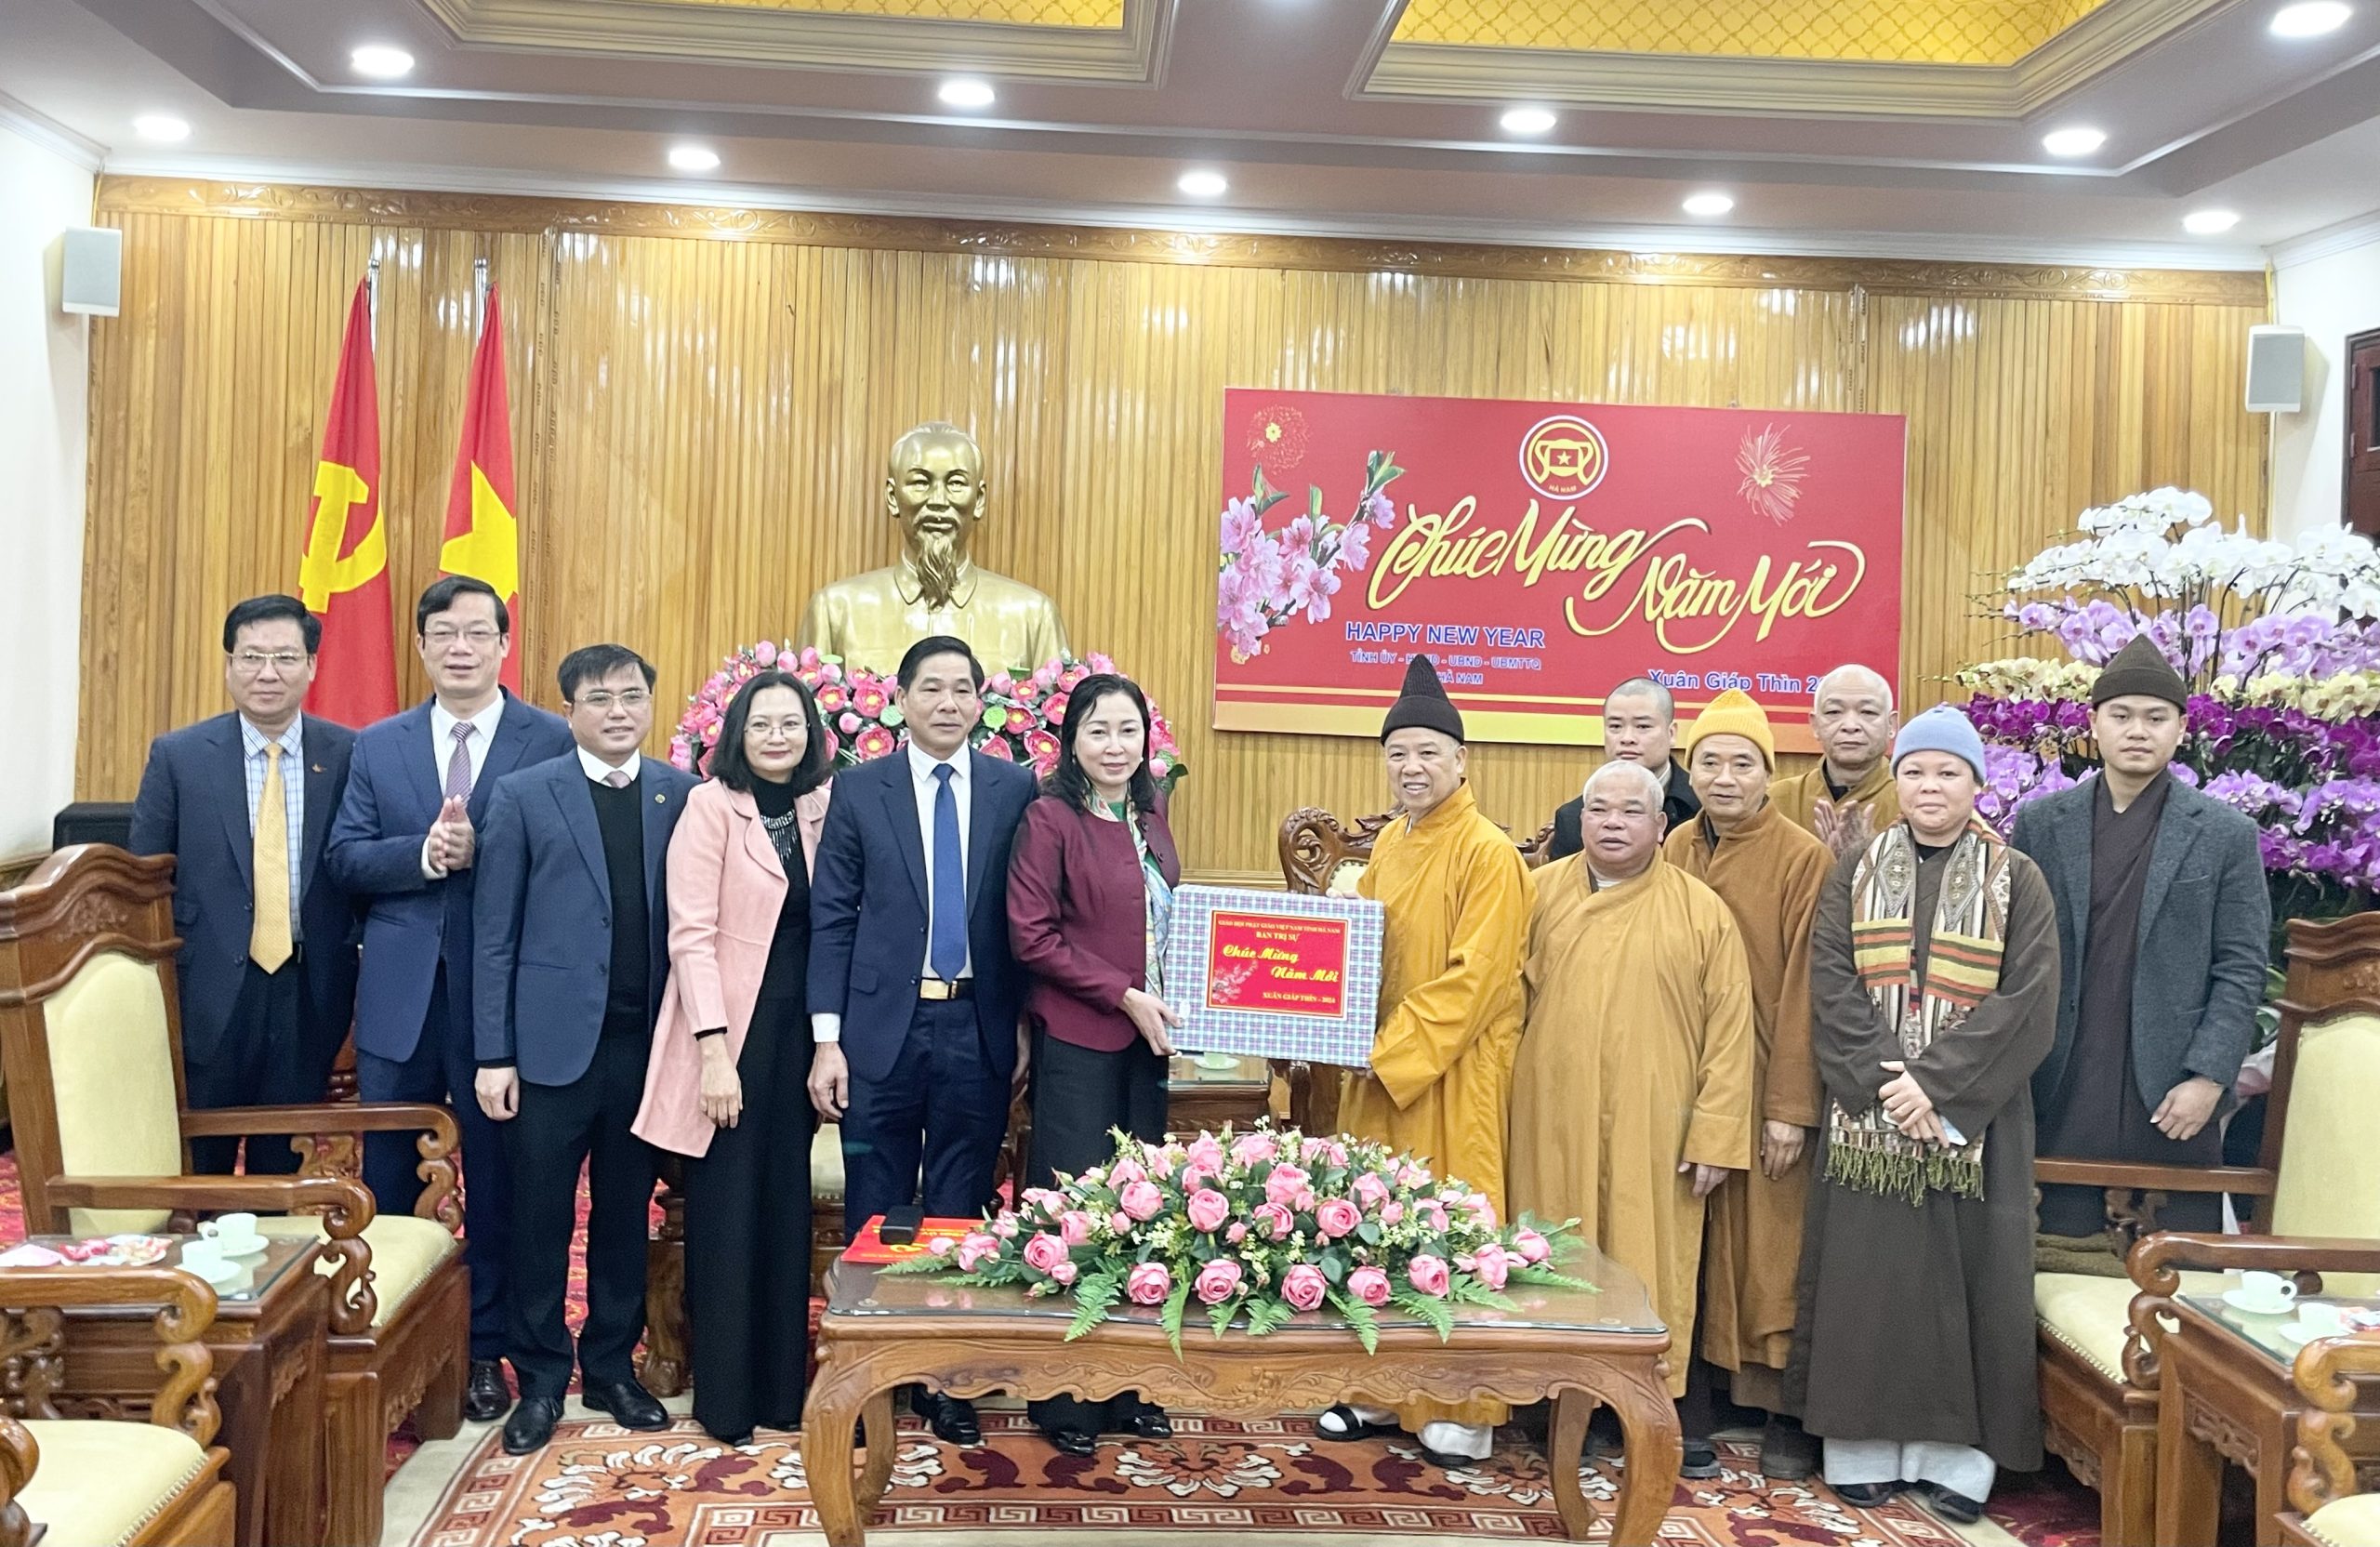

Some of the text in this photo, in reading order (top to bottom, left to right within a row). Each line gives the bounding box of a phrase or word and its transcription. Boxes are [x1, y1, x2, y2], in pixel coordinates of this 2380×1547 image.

[1561, 484, 1578, 494] NAM
[1366, 495, 1712, 611] Chúc Mừng
[1564, 539, 1866, 654] Năm Mới
[1345, 621, 1546, 649] HAPPY NEW YEAR
[1350, 647, 1378, 664] TỈNH
[1380, 648, 1397, 664] ỦY
[1448, 654, 1482, 668] UBND
[1491, 656, 1542, 670] UBMTTQ
[1456, 672, 1484, 685] NAM
[1647, 668, 1699, 690] Xuân
[1704, 671, 1752, 692] Giáp
[1757, 674, 1802, 694] Thìn
[1256, 931, 1302, 943] BAN TRỊ SỰ
[1223, 944, 1300, 964] Chúc Mừng
[1263, 991, 1282, 999] XUÂN
